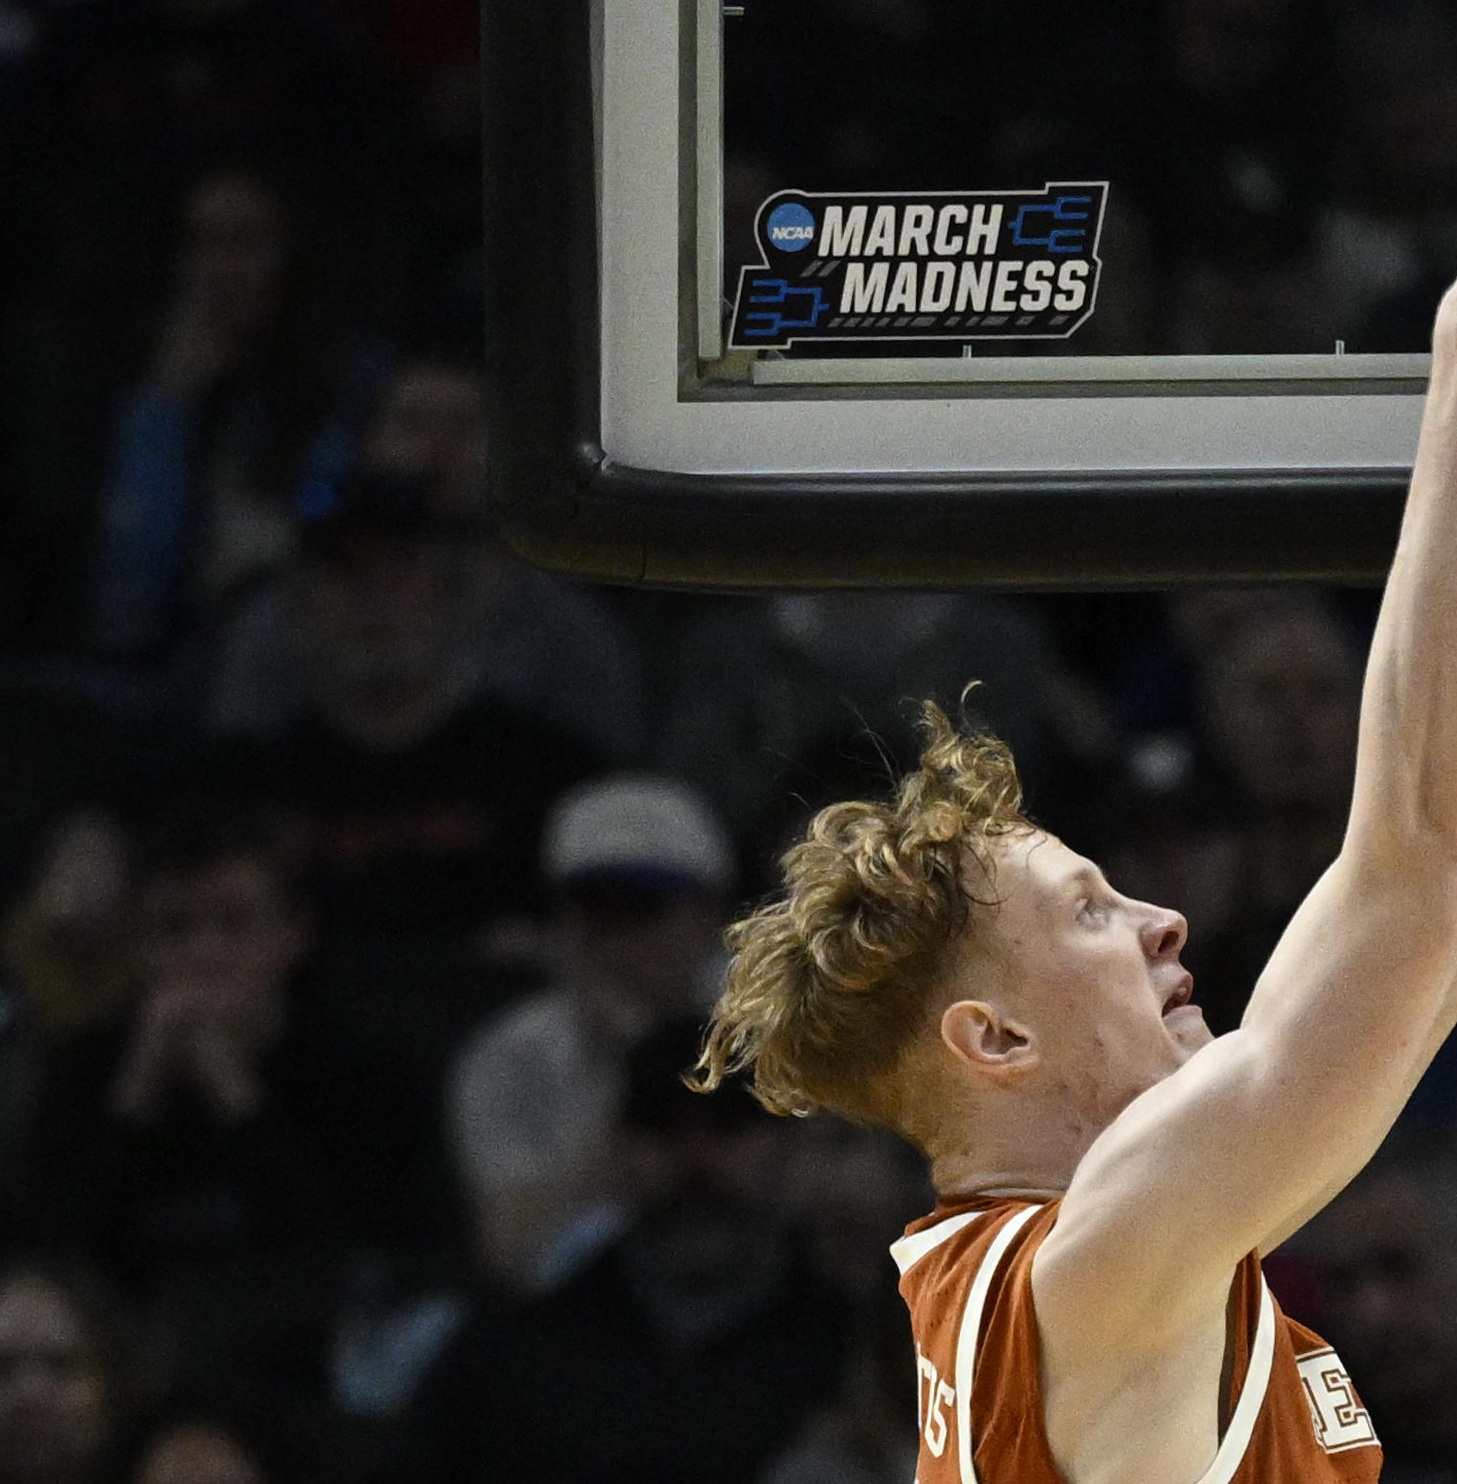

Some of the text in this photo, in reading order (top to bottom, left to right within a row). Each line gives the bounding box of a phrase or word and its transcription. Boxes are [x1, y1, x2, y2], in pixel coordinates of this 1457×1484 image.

[771, 226, 815, 241] NCAA
[817, 203, 1005, 258] MARCH
[838, 259, 1091, 314] MADNESS
